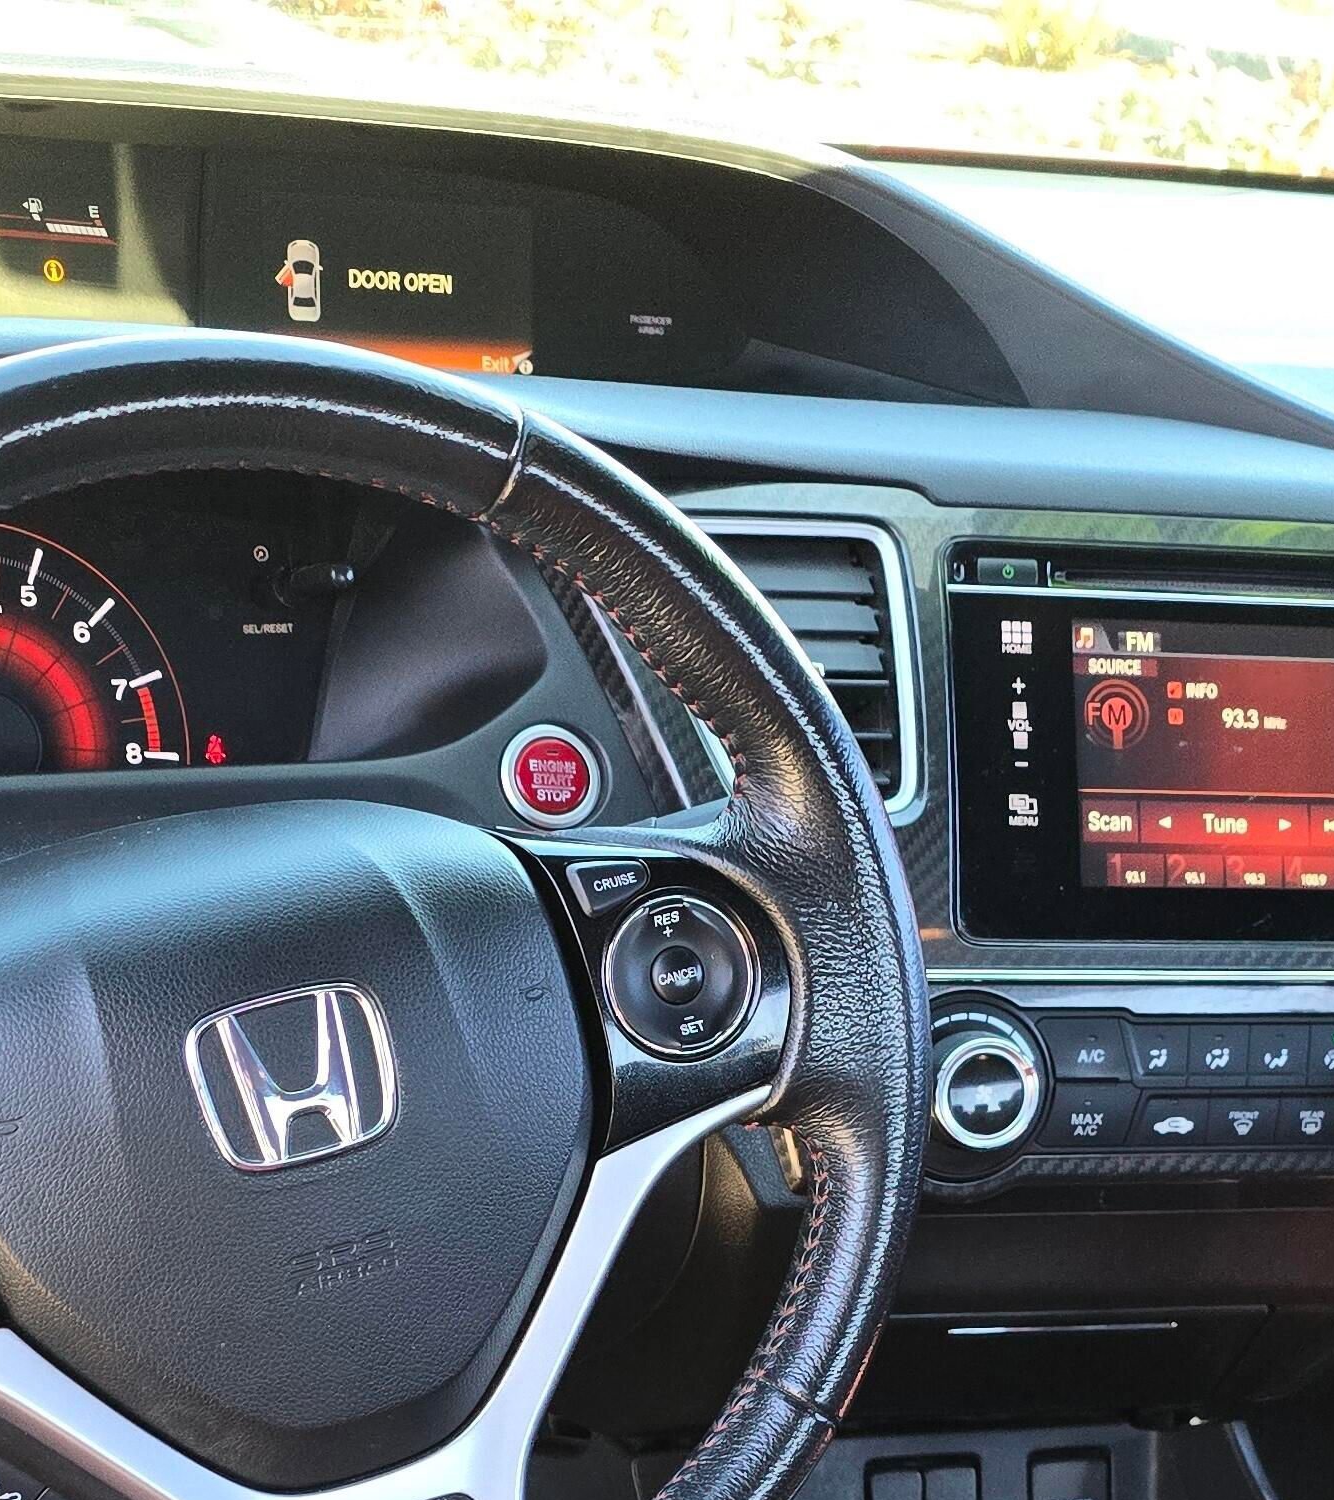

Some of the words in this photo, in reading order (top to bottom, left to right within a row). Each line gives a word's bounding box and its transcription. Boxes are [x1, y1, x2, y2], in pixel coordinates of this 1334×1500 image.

[88, 205, 99, 218] E
[348, 268, 401, 292] DOOR
[404, 273, 453, 295] OPEN
[482, 355, 510, 372] Exit
[19, 585, 39, 607] 5
[72, 622, 91, 644] 6
[242, 623, 294, 635] SEL/RESET
[1001, 643, 1033, 654] HOME
[1125, 631, 1154, 652] FM
[1087, 658, 1142, 675] SOURCE
[110, 679, 128, 701] 7
[1185, 682, 1218, 699] INFO
[1007, 718, 1033, 731] VOL
[1221, 708, 1259, 729] 93.3
[125, 743, 143, 765] 8
[528, 758, 577, 775] ENGINE
[532, 773, 575, 788] START
[536, 788, 572, 803] STOP
[1008, 815, 1039, 827] MENU
[1087, 810, 1133, 832] Scan
[1202, 813, 1248, 834] Tune
[593, 871, 638, 892] CRUISE
[653, 910, 680, 927] RES
[658, 966, 700, 985] CANCEL
[679, 1019, 705, 1036] SET
[1077, 1049, 1106, 1064] A/C
[1070, 1113, 1104, 1126] MAX
[1073, 1124, 1098, 1137] A/C
